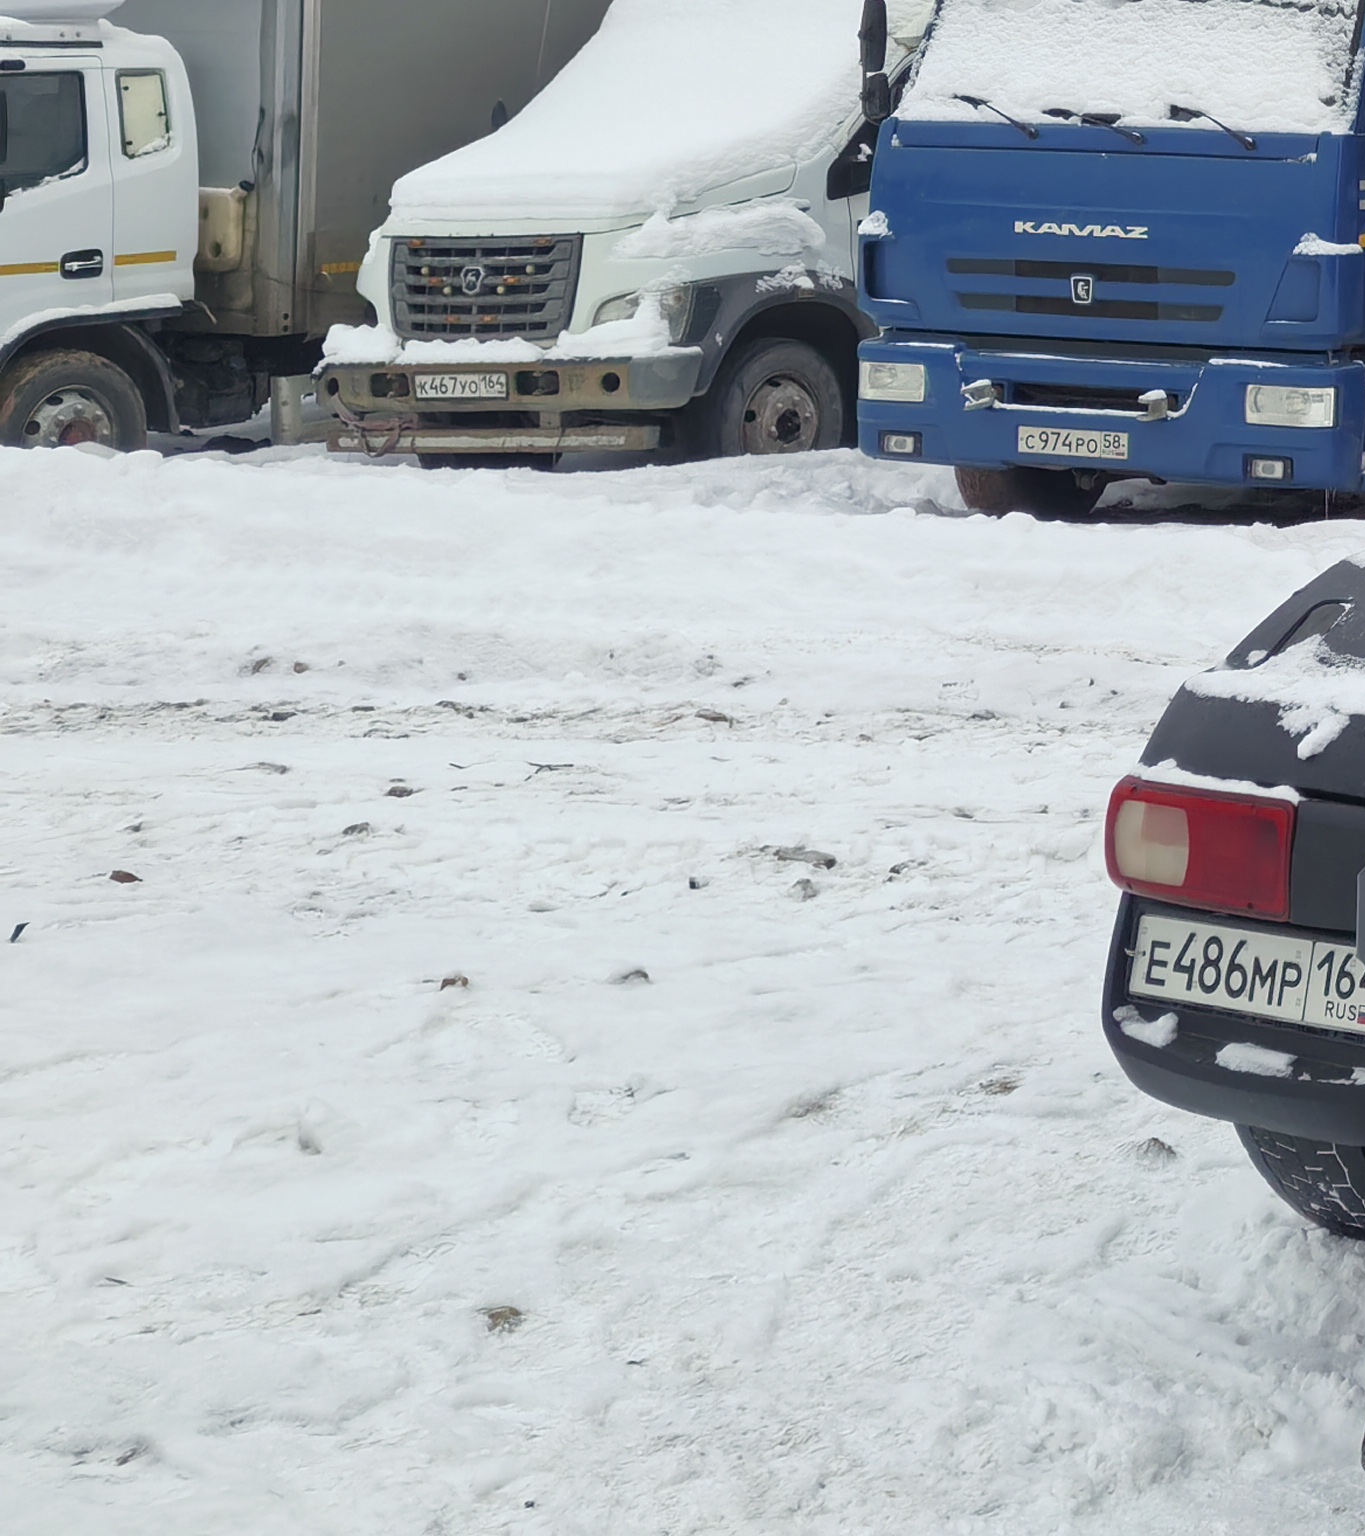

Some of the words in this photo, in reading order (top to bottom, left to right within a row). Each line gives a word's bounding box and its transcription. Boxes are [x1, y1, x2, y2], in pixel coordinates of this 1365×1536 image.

[1014, 221, 1148, 239] KAMAZ
[420, 376, 478, 395] К467УО
[481, 375, 504, 389] 164
[1025, 431, 1098, 453] С974РО
[1103, 434, 1121, 449] 58
[1145, 932, 1303, 1007] Е486МР
[1324, 1001, 1357, 1022] RUS
